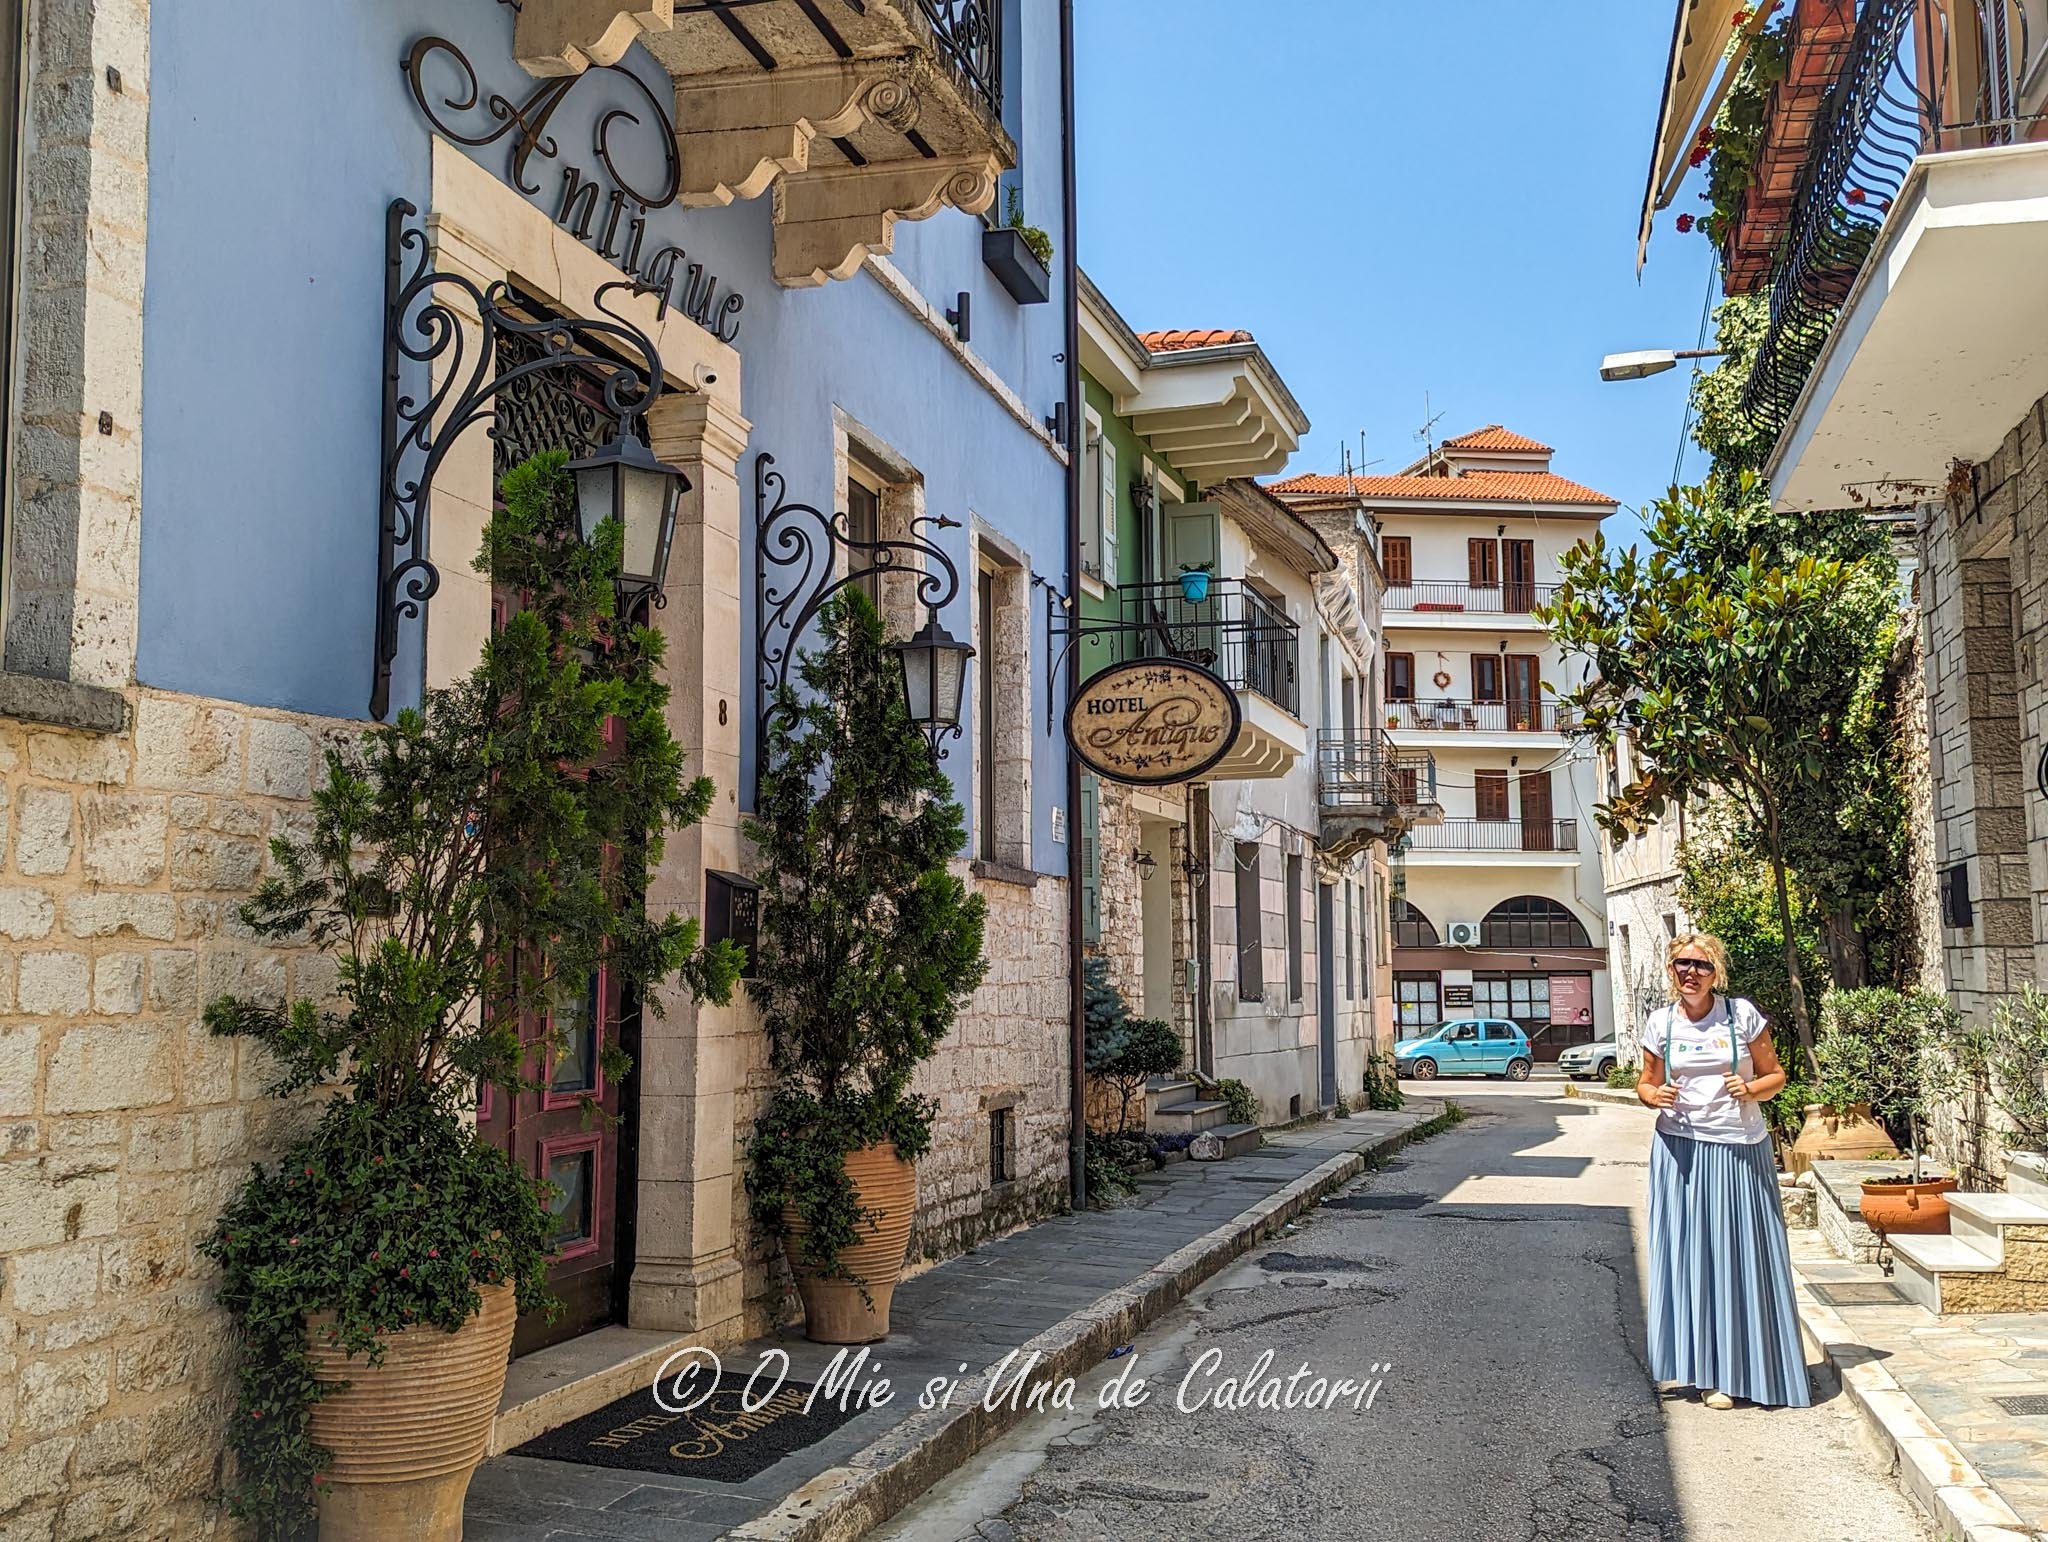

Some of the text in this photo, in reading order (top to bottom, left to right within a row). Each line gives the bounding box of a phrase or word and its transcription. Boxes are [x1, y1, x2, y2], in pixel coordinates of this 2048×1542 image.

[407, 36, 745, 343] Antique
[718, 698, 728, 726] 8
[1087, 697, 1149, 715] HOTEL
[588, 1414, 681, 1449] HOTEL
